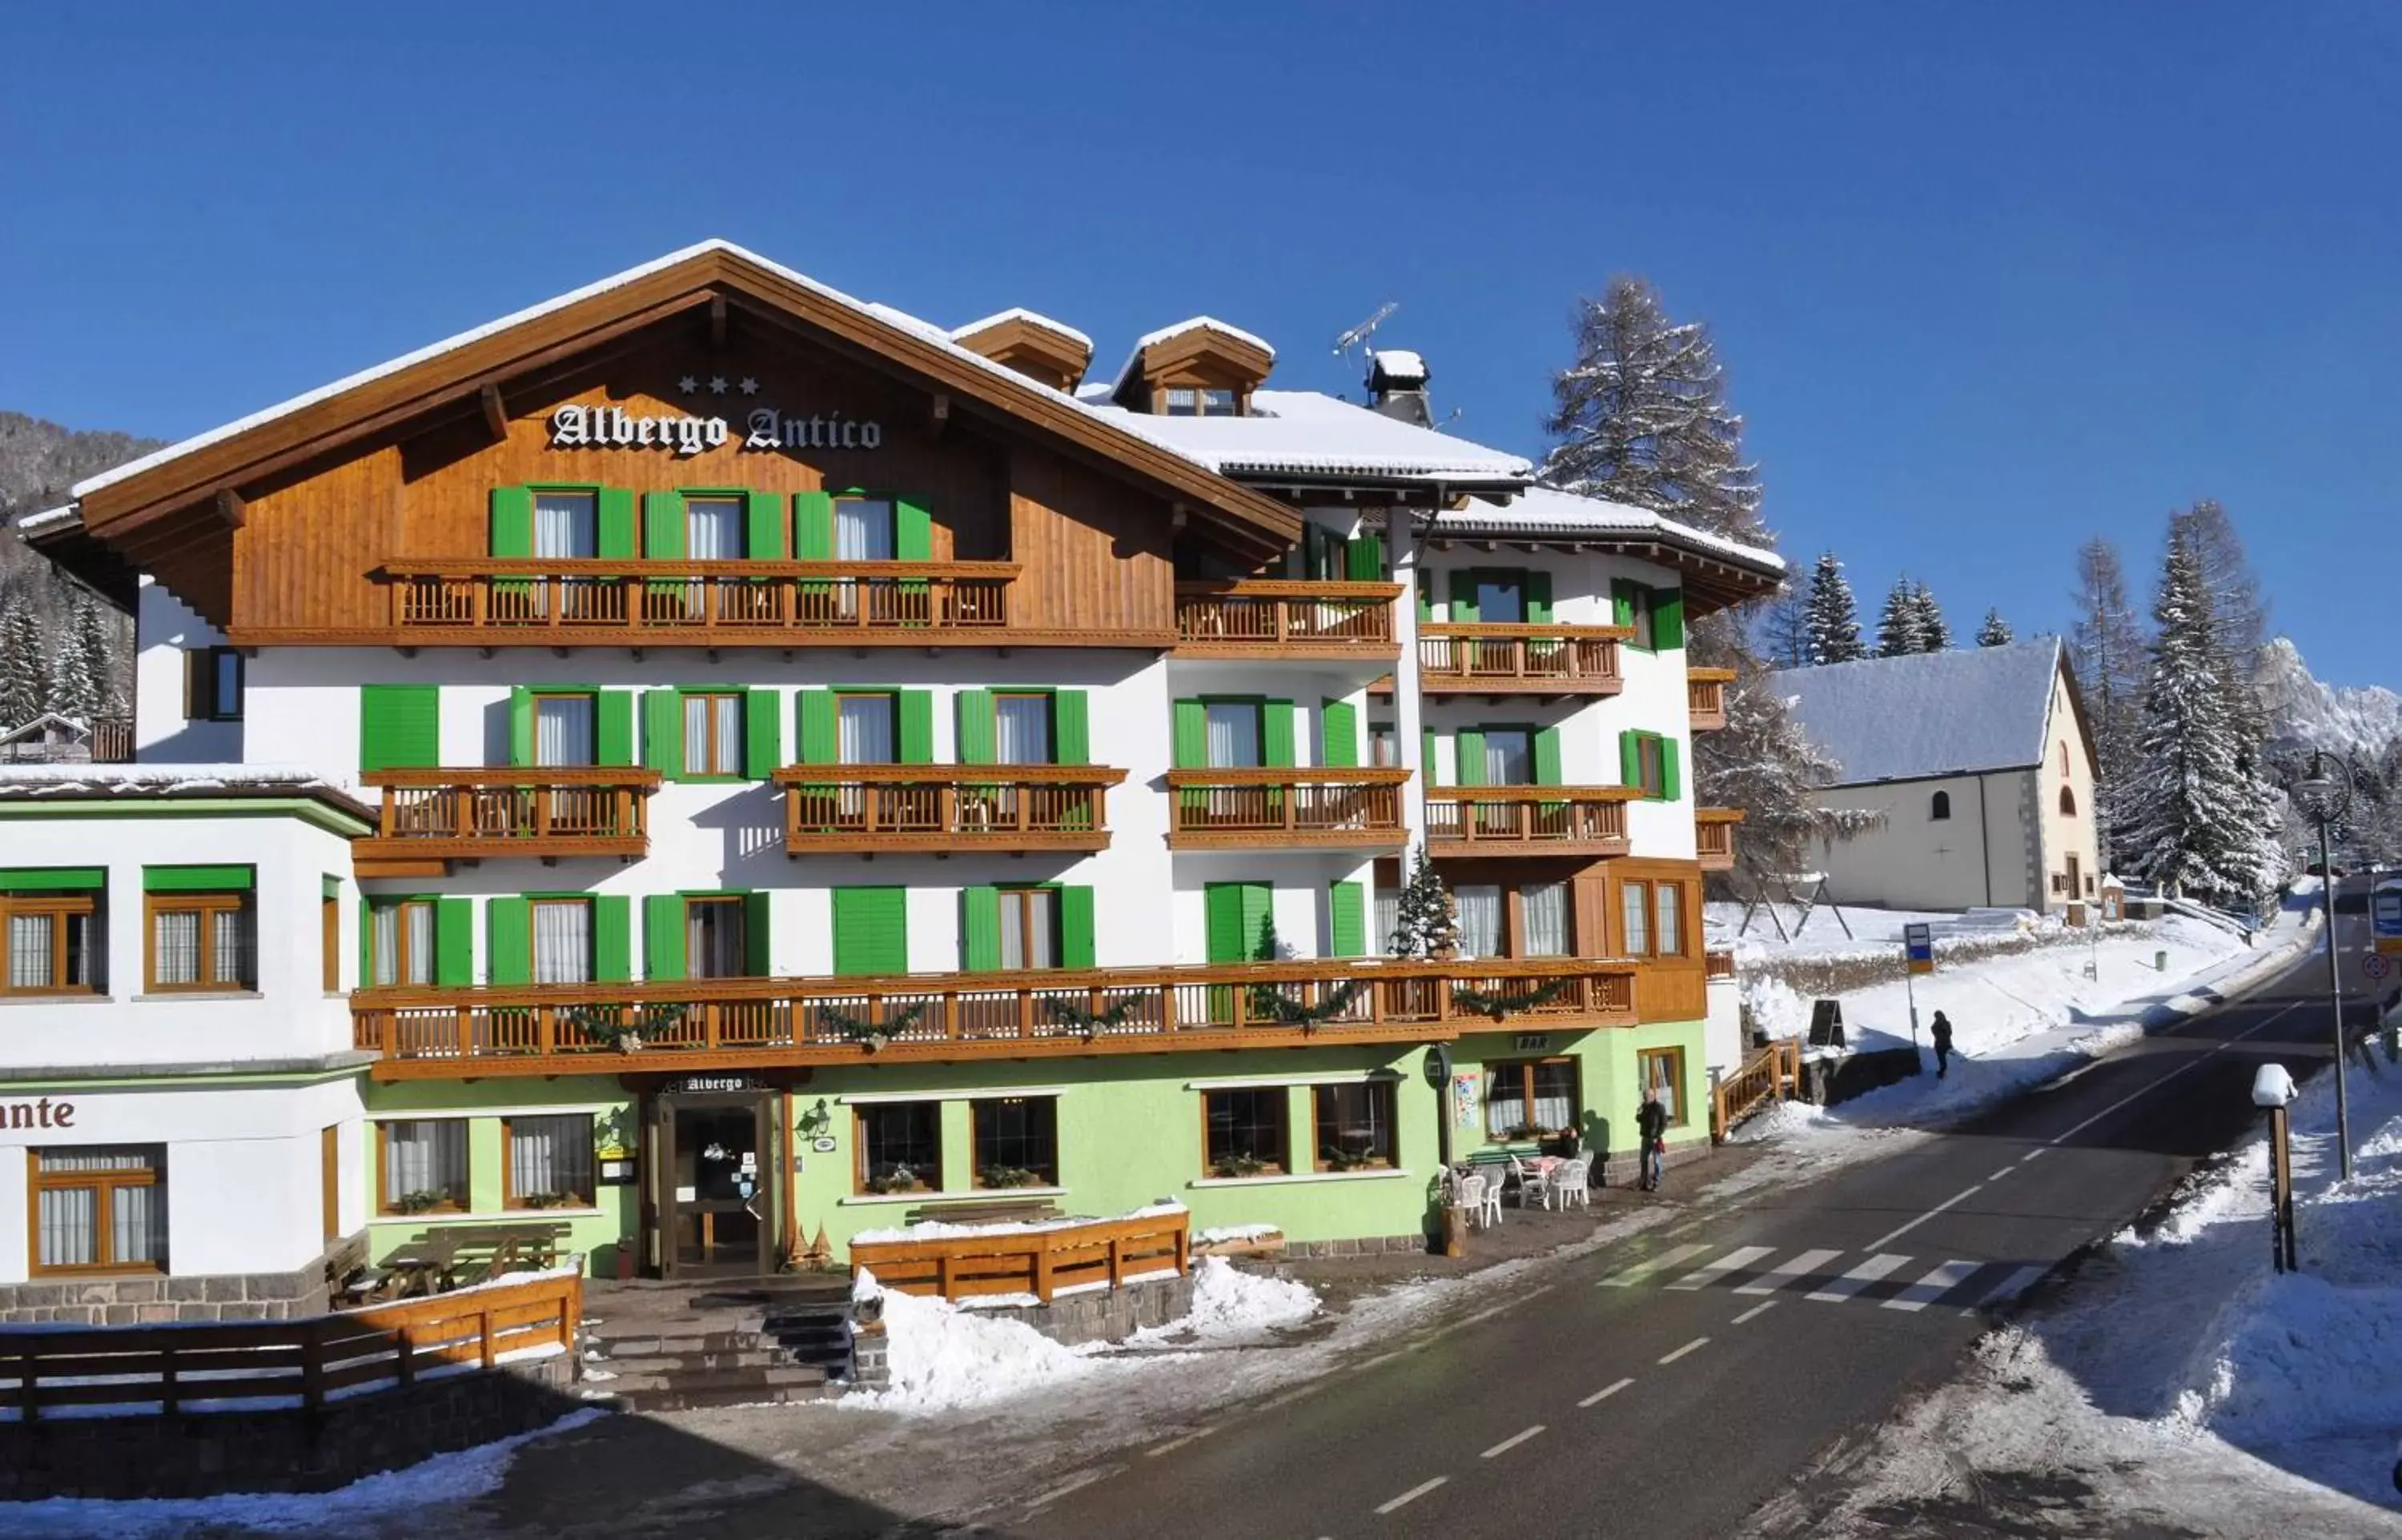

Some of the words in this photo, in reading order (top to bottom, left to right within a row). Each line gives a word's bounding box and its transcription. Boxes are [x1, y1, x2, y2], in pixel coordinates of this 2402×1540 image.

[553, 404, 728, 454] Albergo
[745, 407, 881, 448] Antico
[687, 1077, 742, 1091] Albergo
